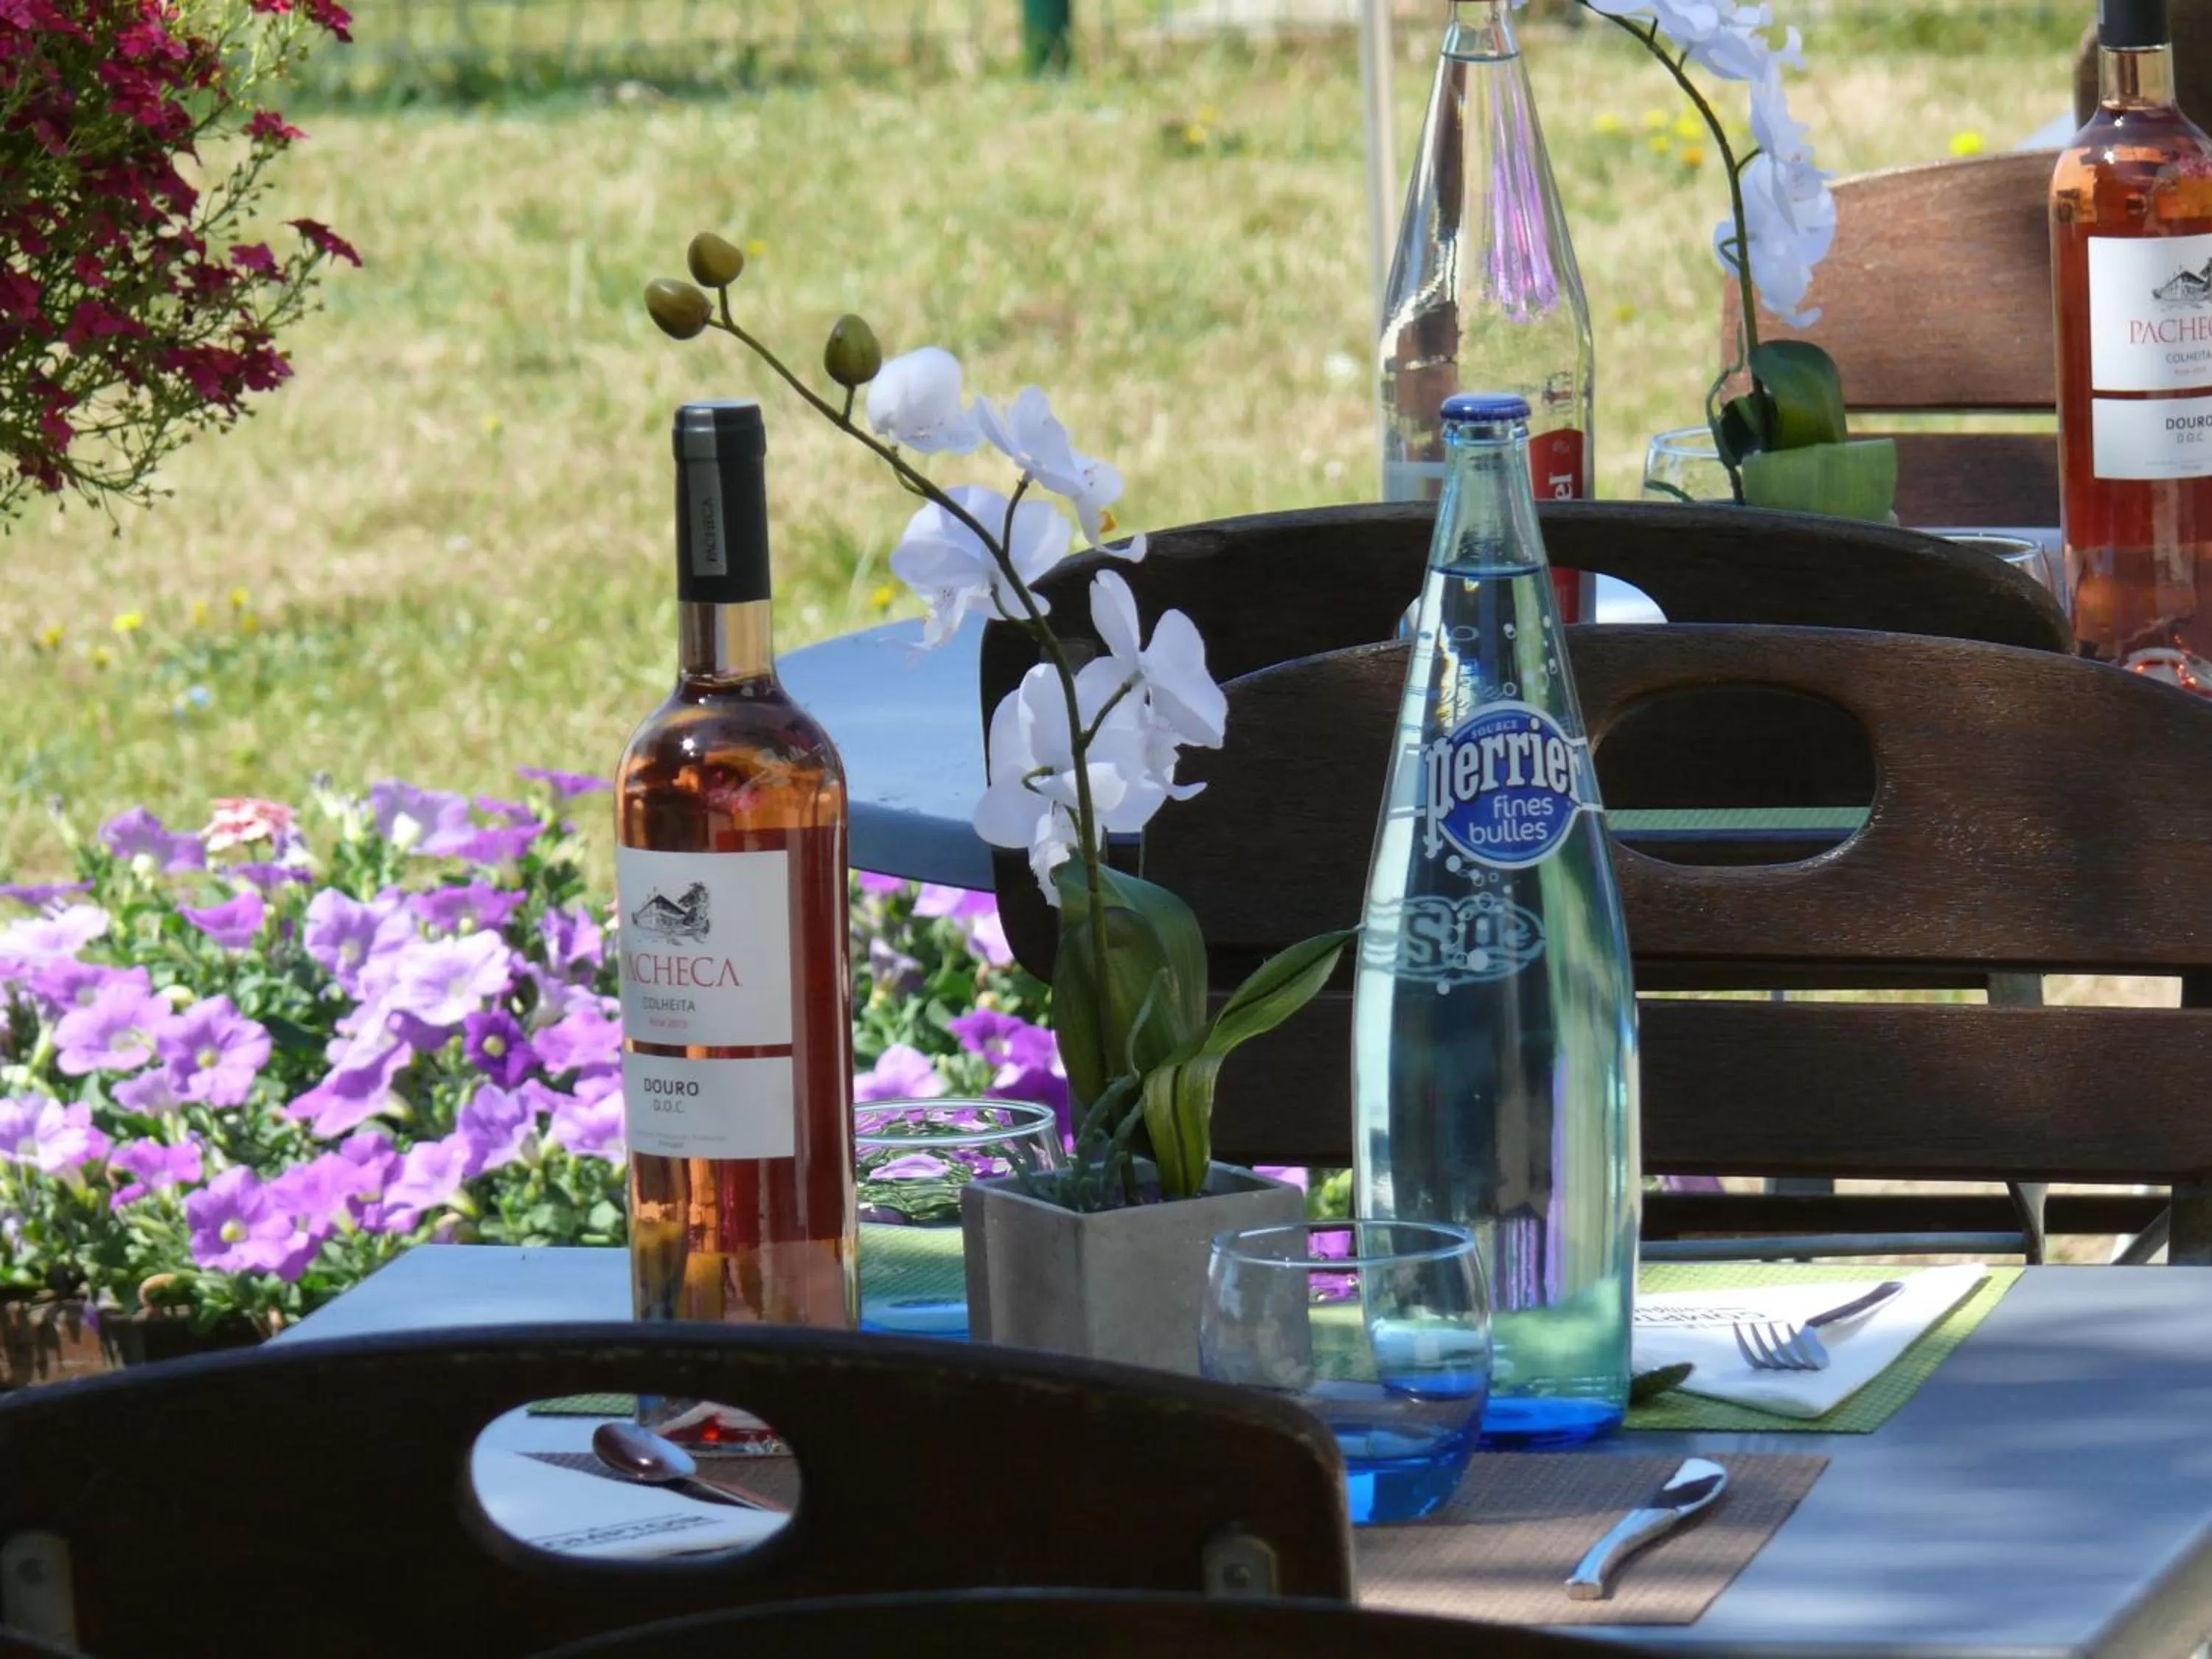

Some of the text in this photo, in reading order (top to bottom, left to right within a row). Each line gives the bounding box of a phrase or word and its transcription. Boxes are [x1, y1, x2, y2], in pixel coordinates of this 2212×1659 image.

[2129, 316, 2212, 344] PACHE
[1493, 794, 1554, 819] fines
[1469, 819, 1548, 844] bulles
[625, 952, 743, 987] ACHECA
[644, 1077, 700, 1096] DOURO
